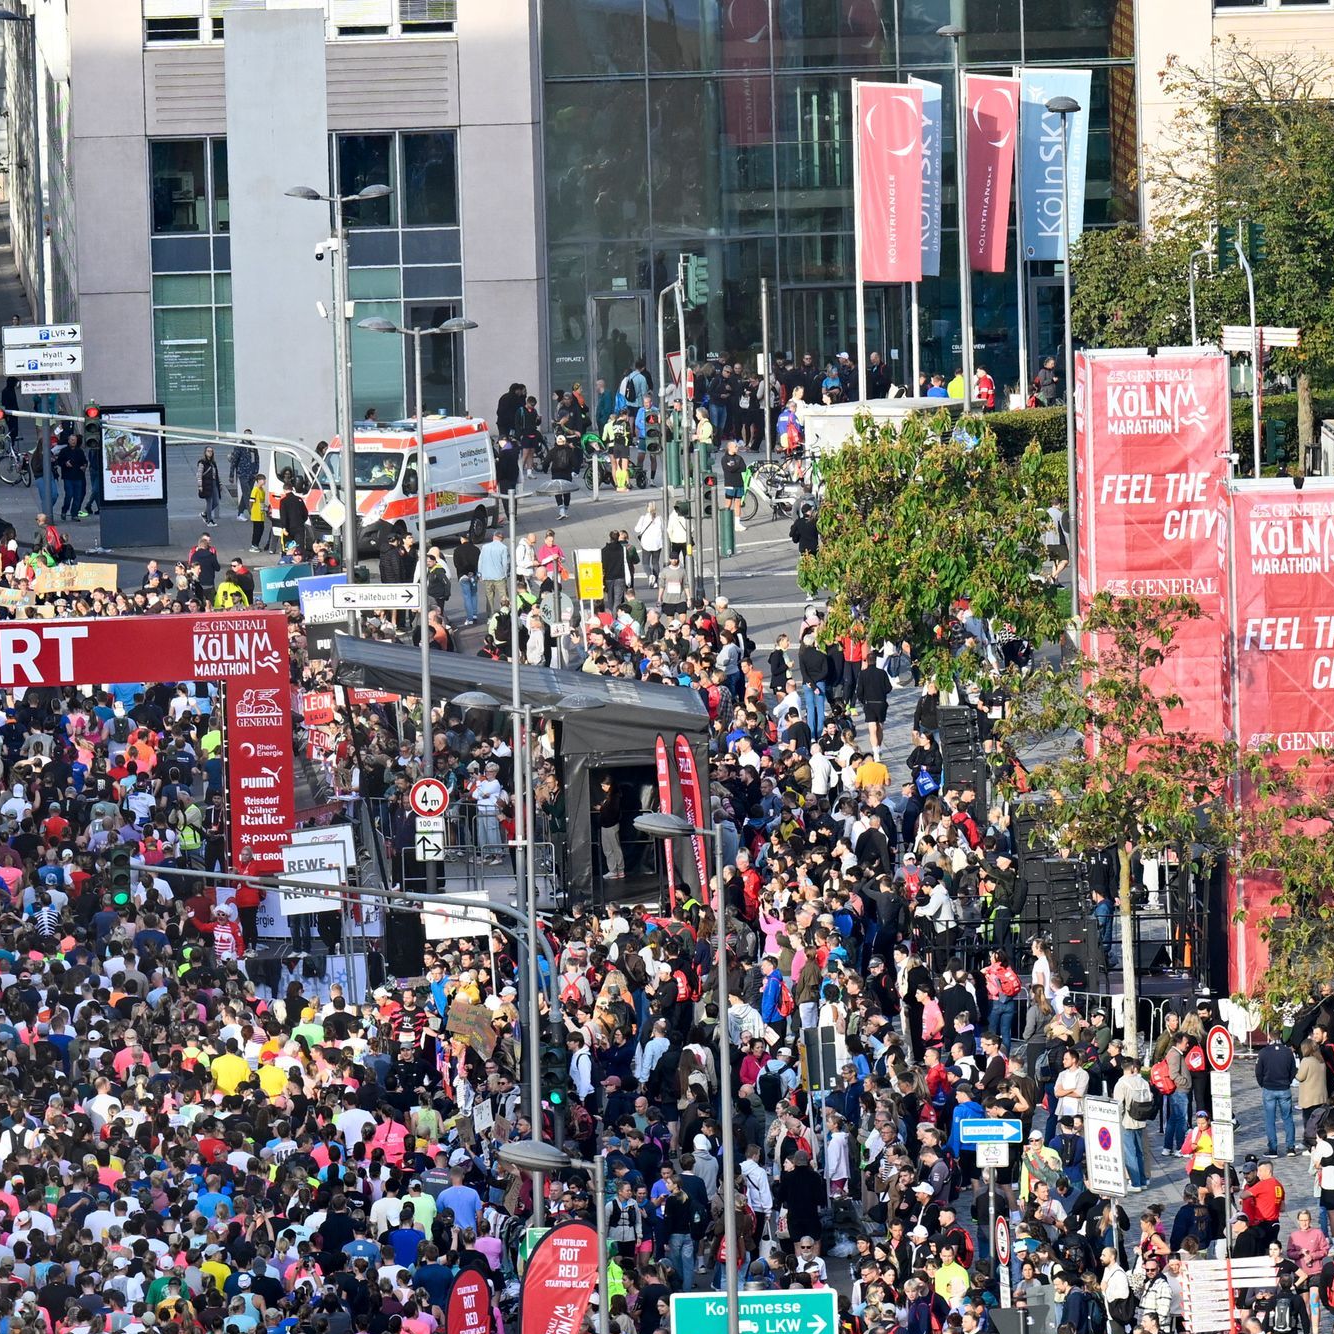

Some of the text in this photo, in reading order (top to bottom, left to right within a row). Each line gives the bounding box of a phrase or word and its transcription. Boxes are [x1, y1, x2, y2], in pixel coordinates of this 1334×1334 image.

[888, 174, 897, 264] KÖLNTRIANGLE
[51, 330, 66, 338] LVR
[42, 351, 63, 360] Hyatt
[1126, 369, 1194, 383] GENERALI
[1106, 385, 1172, 418] KÖLN
[1107, 418, 1172, 435] MARATHON
[110, 461, 156, 475] WIRD
[110, 475, 156, 484] GEMACHT.
[1101, 472, 1210, 504] FEEL THE
[1163, 510, 1219, 542] CITY
[1250, 519, 1322, 557] KÖLN
[1251, 557, 1322, 576] MARATHON
[359, 592, 398, 601] Haltebucht
[210, 619, 267, 632] GENERALI
[1244, 617, 1305, 653] FEEL
[193, 633, 249, 661] KÖLN
[194, 661, 249, 677] MARATHON
[354, 691, 388, 699] GENERALI
[304, 694, 331, 711] LEON
[237, 717, 283, 728] GENERALI
[257, 743, 277, 751] Rhein
[257, 749, 283, 758] Energie
[240, 778, 274, 789] PUMA
[244, 796, 279, 805] Reissdorf
[420, 790, 440, 807] 4 m
[247, 805, 278, 814] Kölner
[240, 814, 286, 826] Radler
[419, 819, 432, 828] 100
[250, 832, 288, 843] pixum
[287, 858, 326, 872] REWE
[553, 1238, 588, 1248] STARTBLOCK
[559, 1248, 580, 1262] ROT
[558, 1264, 579, 1278] RED
[544, 1279, 590, 1289] STARTING BLOCK
[463, 1294, 476, 1309] ROT
[465, 1312, 478, 1326] RED
[765, 1319, 801, 1333] LKW
